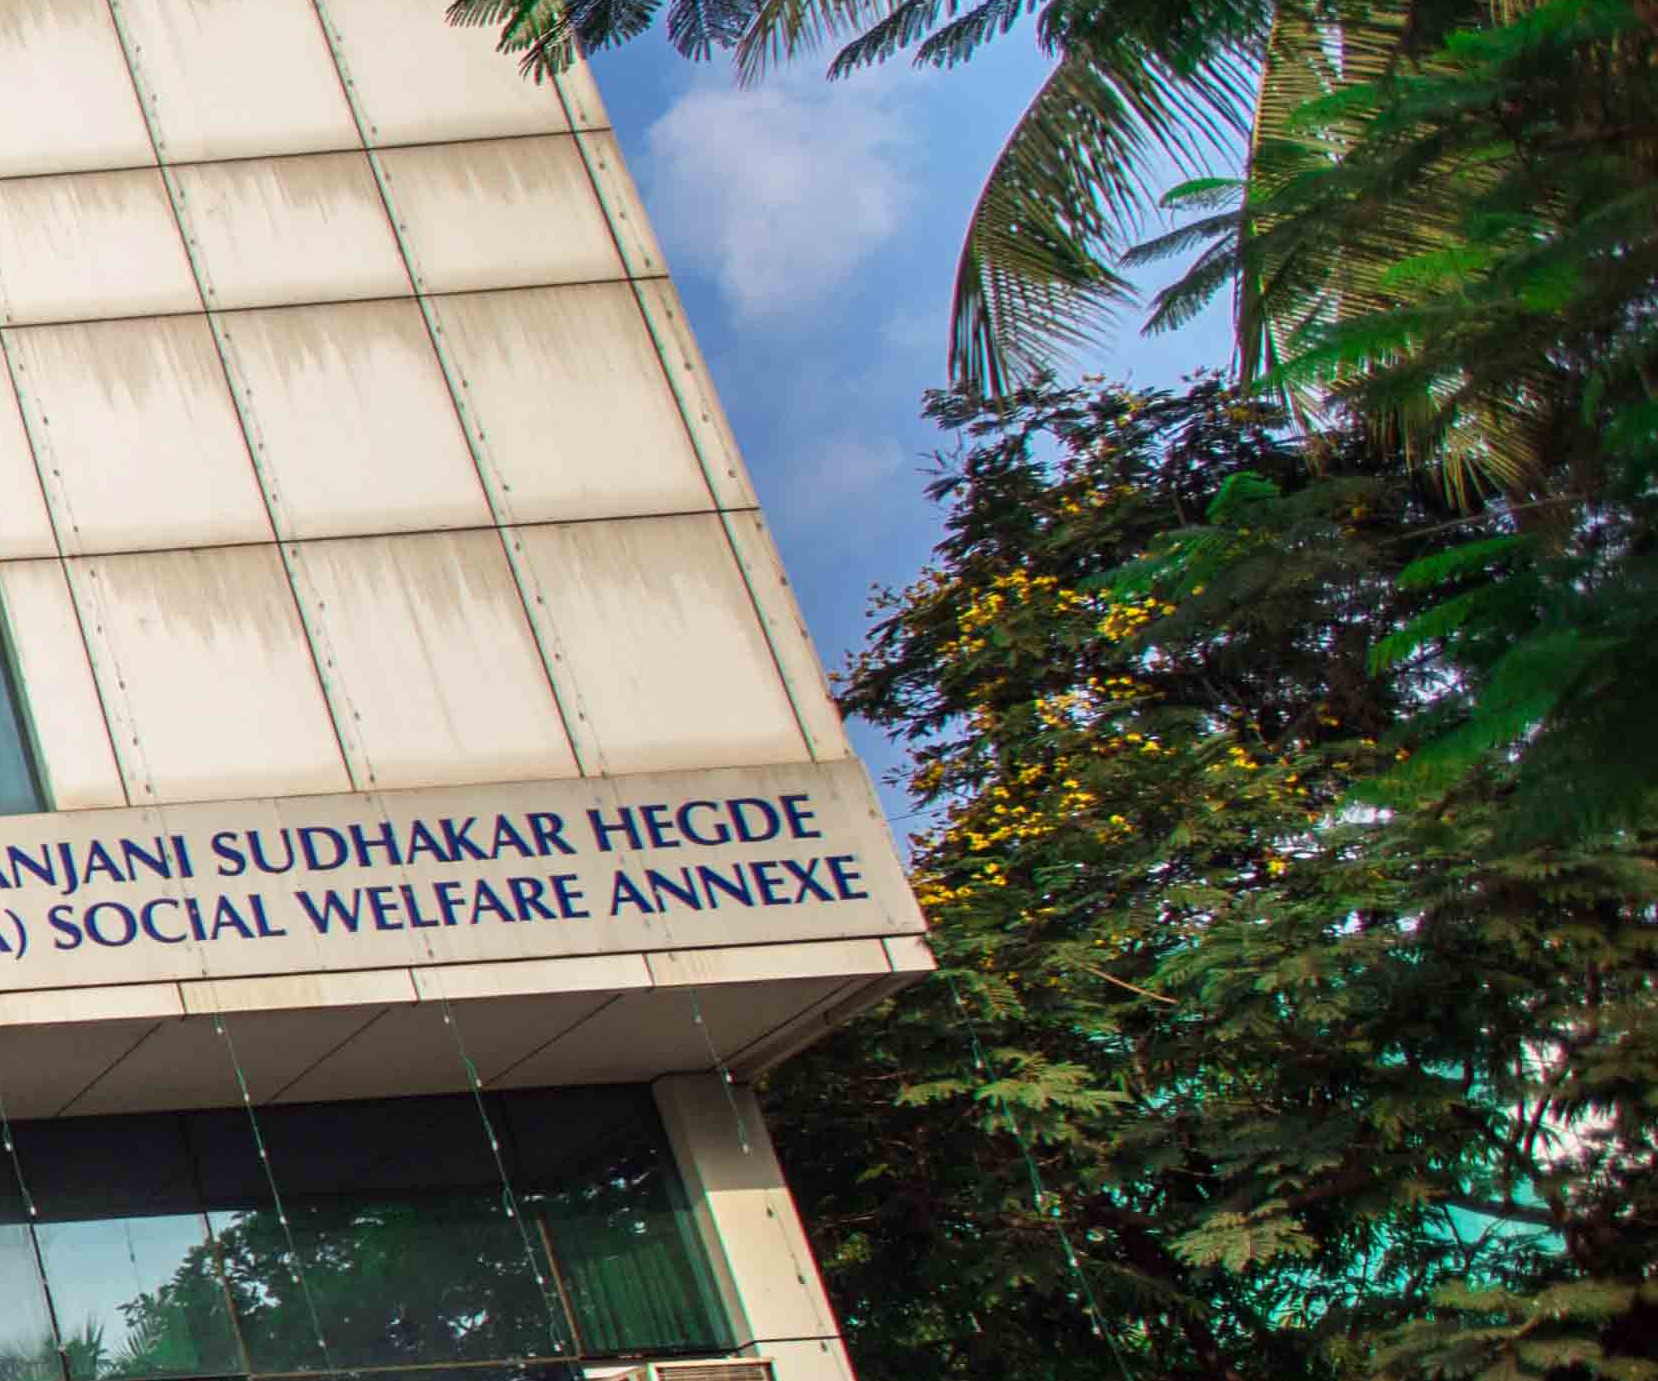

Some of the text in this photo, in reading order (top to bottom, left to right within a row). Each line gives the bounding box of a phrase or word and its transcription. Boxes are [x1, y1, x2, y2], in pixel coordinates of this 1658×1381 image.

[211, 811, 577, 877] SUDHAKAR
[585, 793, 823, 852] HEGDE
[47, 893, 287, 951] SOCIAL
[293, 872, 591, 935] WELFARE
[609, 854, 870, 916] ANNEXE
